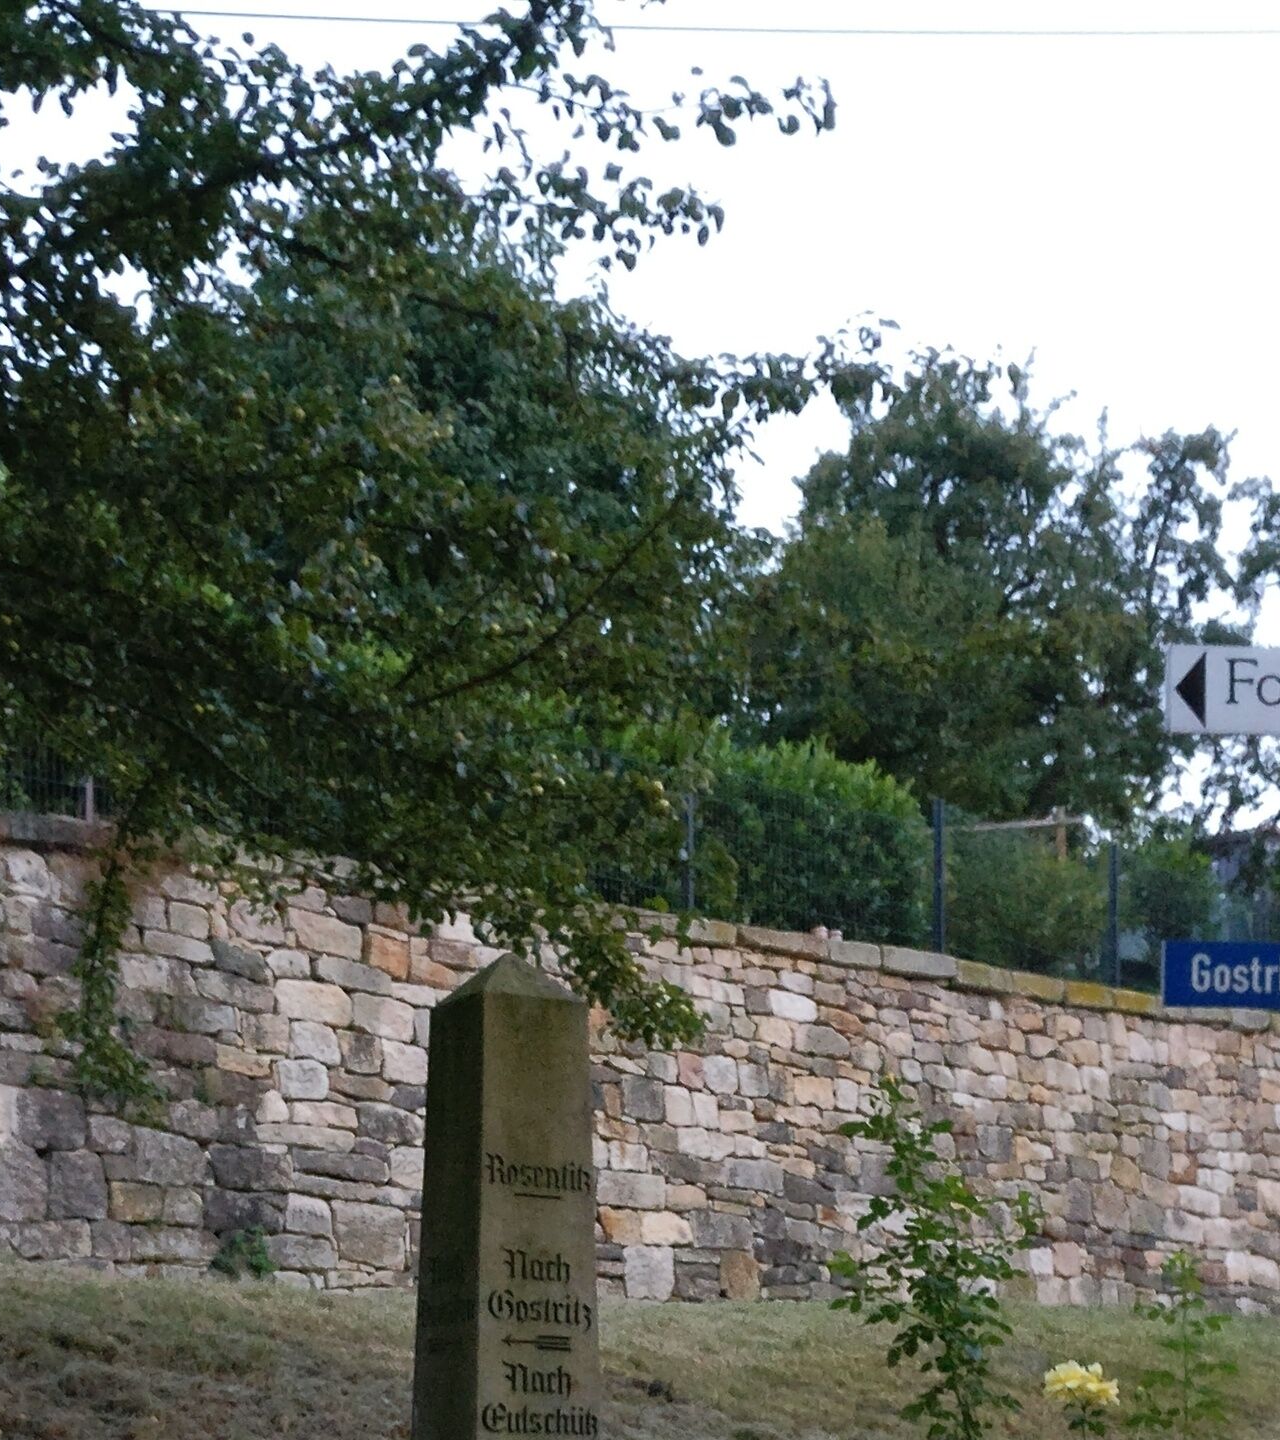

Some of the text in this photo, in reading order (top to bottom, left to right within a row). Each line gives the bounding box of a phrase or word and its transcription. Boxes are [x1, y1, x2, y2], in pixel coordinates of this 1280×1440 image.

[502, 1248, 571, 1285] Nach
[486, 1288, 593, 1333] Gostritz
[501, 1359, 572, 1397] Nach
